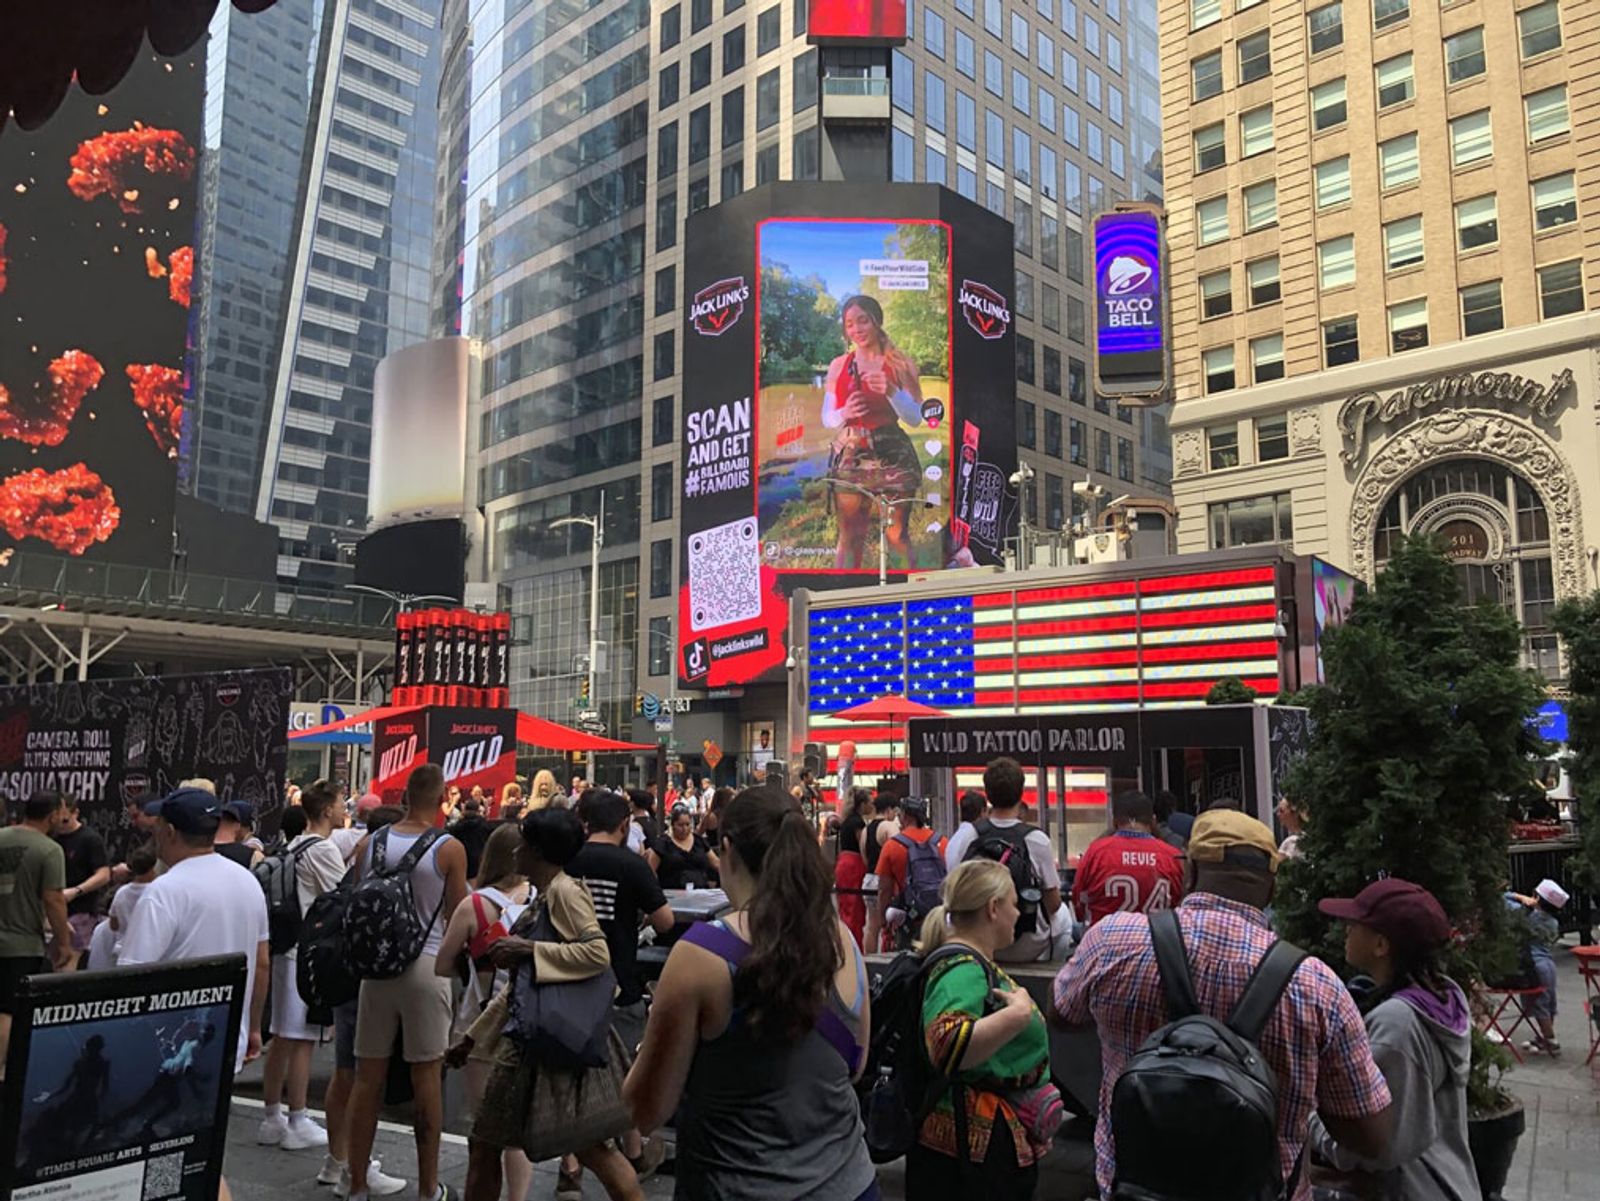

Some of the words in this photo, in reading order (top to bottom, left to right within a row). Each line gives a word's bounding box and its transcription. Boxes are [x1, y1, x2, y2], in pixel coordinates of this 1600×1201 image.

[689, 298, 716, 320] JACK
[958, 287, 982, 312] JACK
[1105, 298, 1153, 313] TACO
[1110, 312, 1153, 328] BELL
[687, 397, 750, 443] SCAN
[1337, 368, 1574, 465] Paramount
[688, 440, 719, 468] AND
[722, 431, 751, 458] GET
[701, 469, 750, 496] FAMOUS
[973, 500, 999, 522] WILD
[27, 730, 80, 749] CAMERA
[83, 730, 111, 748] ROLL
[922, 732, 969, 753] WILD
[972, 729, 1043, 752] TATTOO
[1047, 727, 1126, 752] PARLOR
[24, 751, 49, 768] WITH
[51, 751, 111, 768] SOMETHING
[379, 734, 418, 783] WILD
[442, 735, 504, 783] WILD
[1121, 851, 1157, 867] REVIS
[1104, 874, 1172, 914] 24
[32, 996, 146, 1026] MIDNIGHT
[148, 985, 234, 1011] MOMENT
[77, 1151, 115, 1169] SQUARE
[116, 1145, 143, 1160] ARTS
